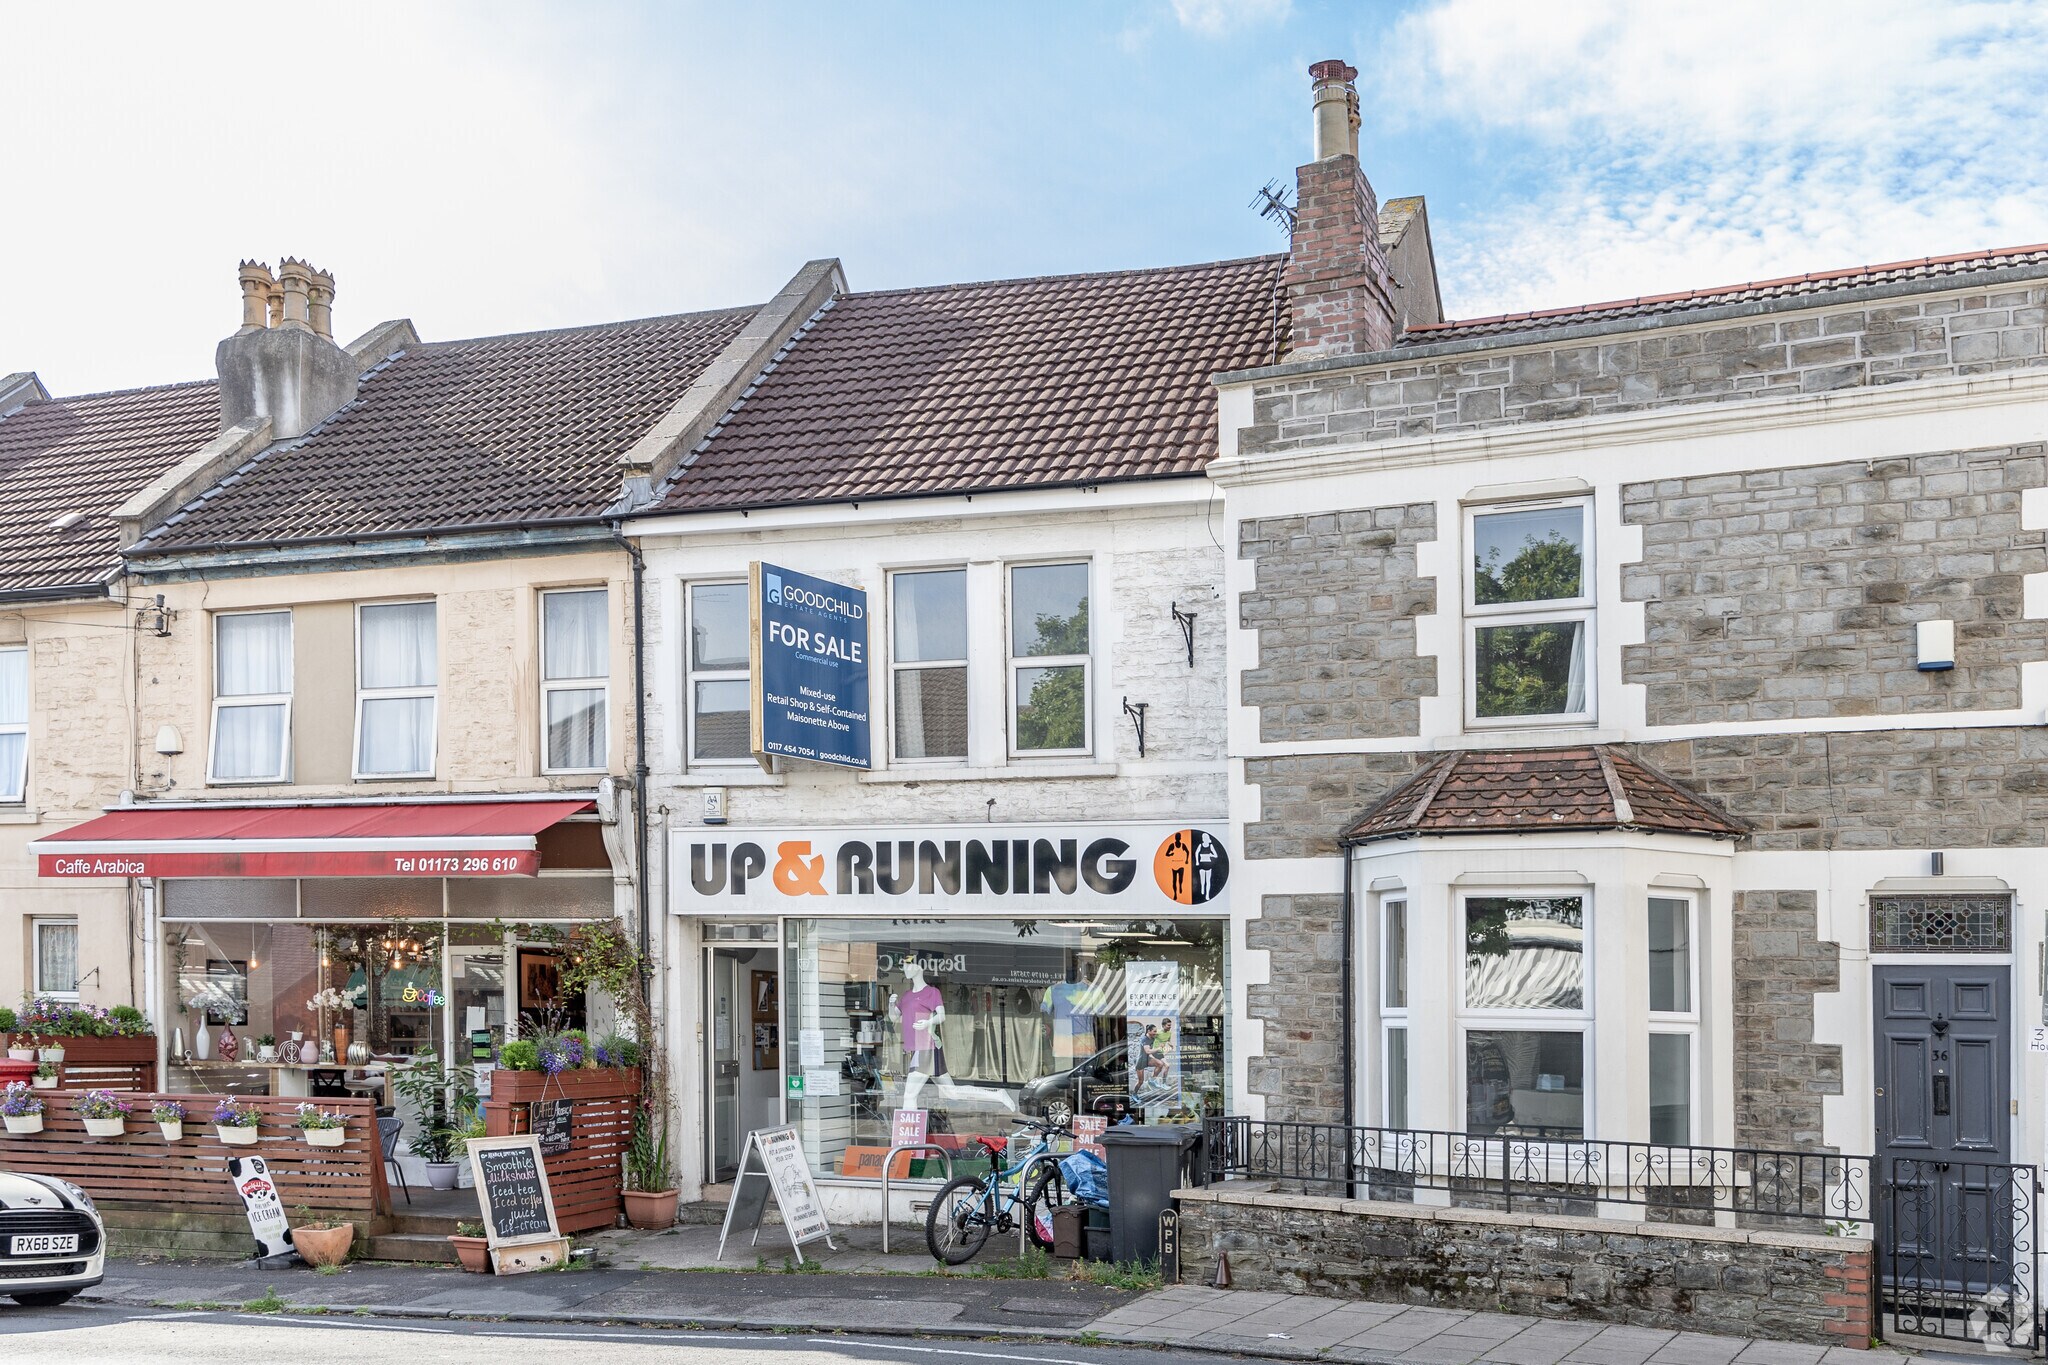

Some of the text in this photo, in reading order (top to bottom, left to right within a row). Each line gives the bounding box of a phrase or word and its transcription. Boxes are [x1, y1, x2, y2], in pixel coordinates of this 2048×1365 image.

[783, 585, 863, 619] GOODCHILD
[784, 601, 848, 624] ESTATE AGENTS
[769, 620, 862, 664] FOR SALE
[795, 651, 829, 666] Commercial
[800, 685, 836, 702] Mixed-use
[767, 693, 867, 722] Retail Shop & Self-Contained
[787, 710, 850, 732] Maisonette Above
[768, 742, 868, 766] 0117 454 7054 goodchild.co.uk
[55, 859, 145, 874] Caffe Arabica
[395, 857, 518, 871] Tel 01173 296 610
[690, 837, 1137, 896] UP & RUNNING
[416, 988, 445, 1006] Coffee
[1129, 993, 1177, 1001] EXPERIENCE
[1932, 1050, 1948, 1061] 36
[900, 1113, 921, 1123] SALE
[1079, 1120, 1101, 1130] SALE
[899, 1126, 920, 1137] SALE
[485, 1157, 535, 1173] Smoothies
[492, 1183, 536, 1198] Iced tea
[494, 1194, 543, 1209] Iced coffee
[498, 1218, 548, 1235] Ice-cream
[17, 1236, 74, 1251] RX68 SZE
